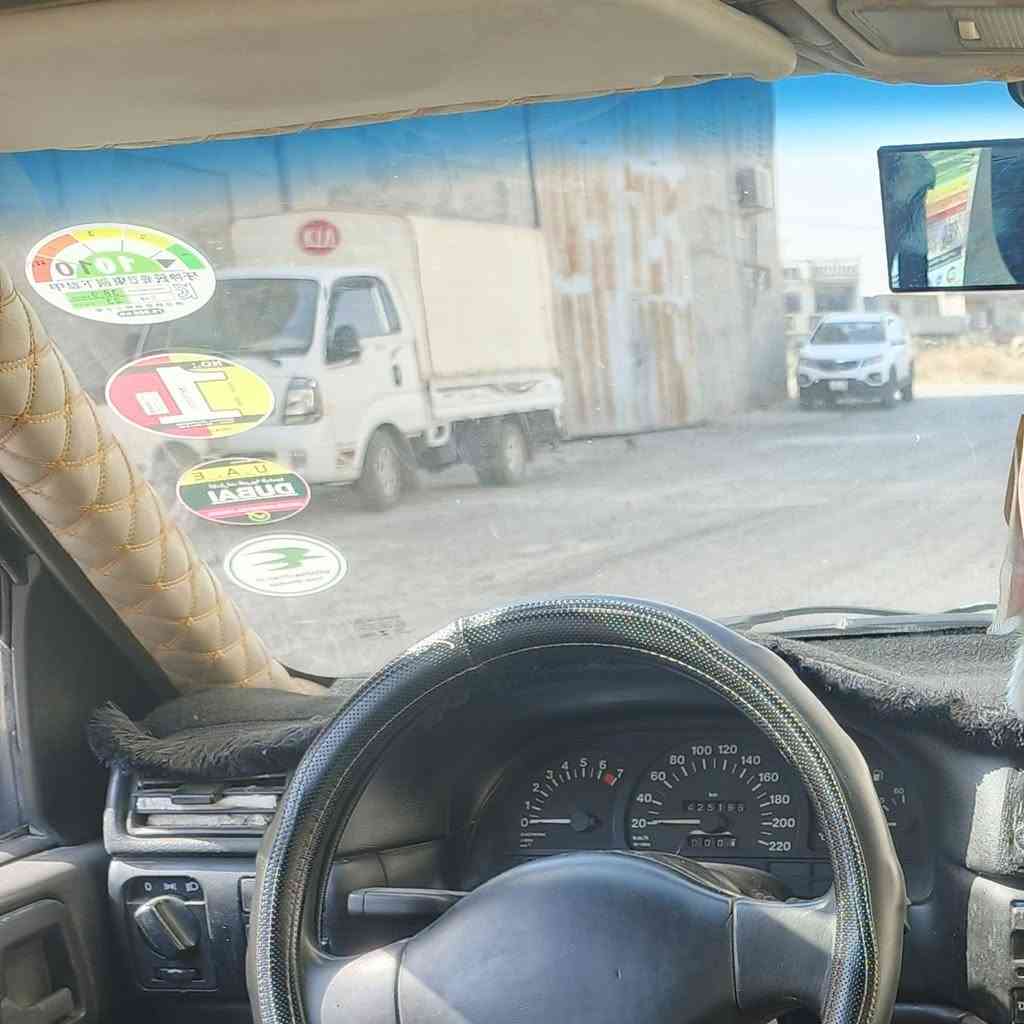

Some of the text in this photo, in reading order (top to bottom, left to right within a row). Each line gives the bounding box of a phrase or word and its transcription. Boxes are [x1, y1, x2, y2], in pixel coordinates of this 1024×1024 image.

[691, 746, 713, 756] 100
[717, 744, 739, 755] 120
[669, 755, 686, 765] 80
[740, 755, 762, 766] 140
[650, 771, 667, 781] 60
[758, 772, 780, 783] 160
[636, 793, 652, 804] 40
[769, 794, 791, 805] 180
[631, 818, 647, 829] 20
[771, 818, 797, 829] 200
[768, 841, 792, 852] 220
